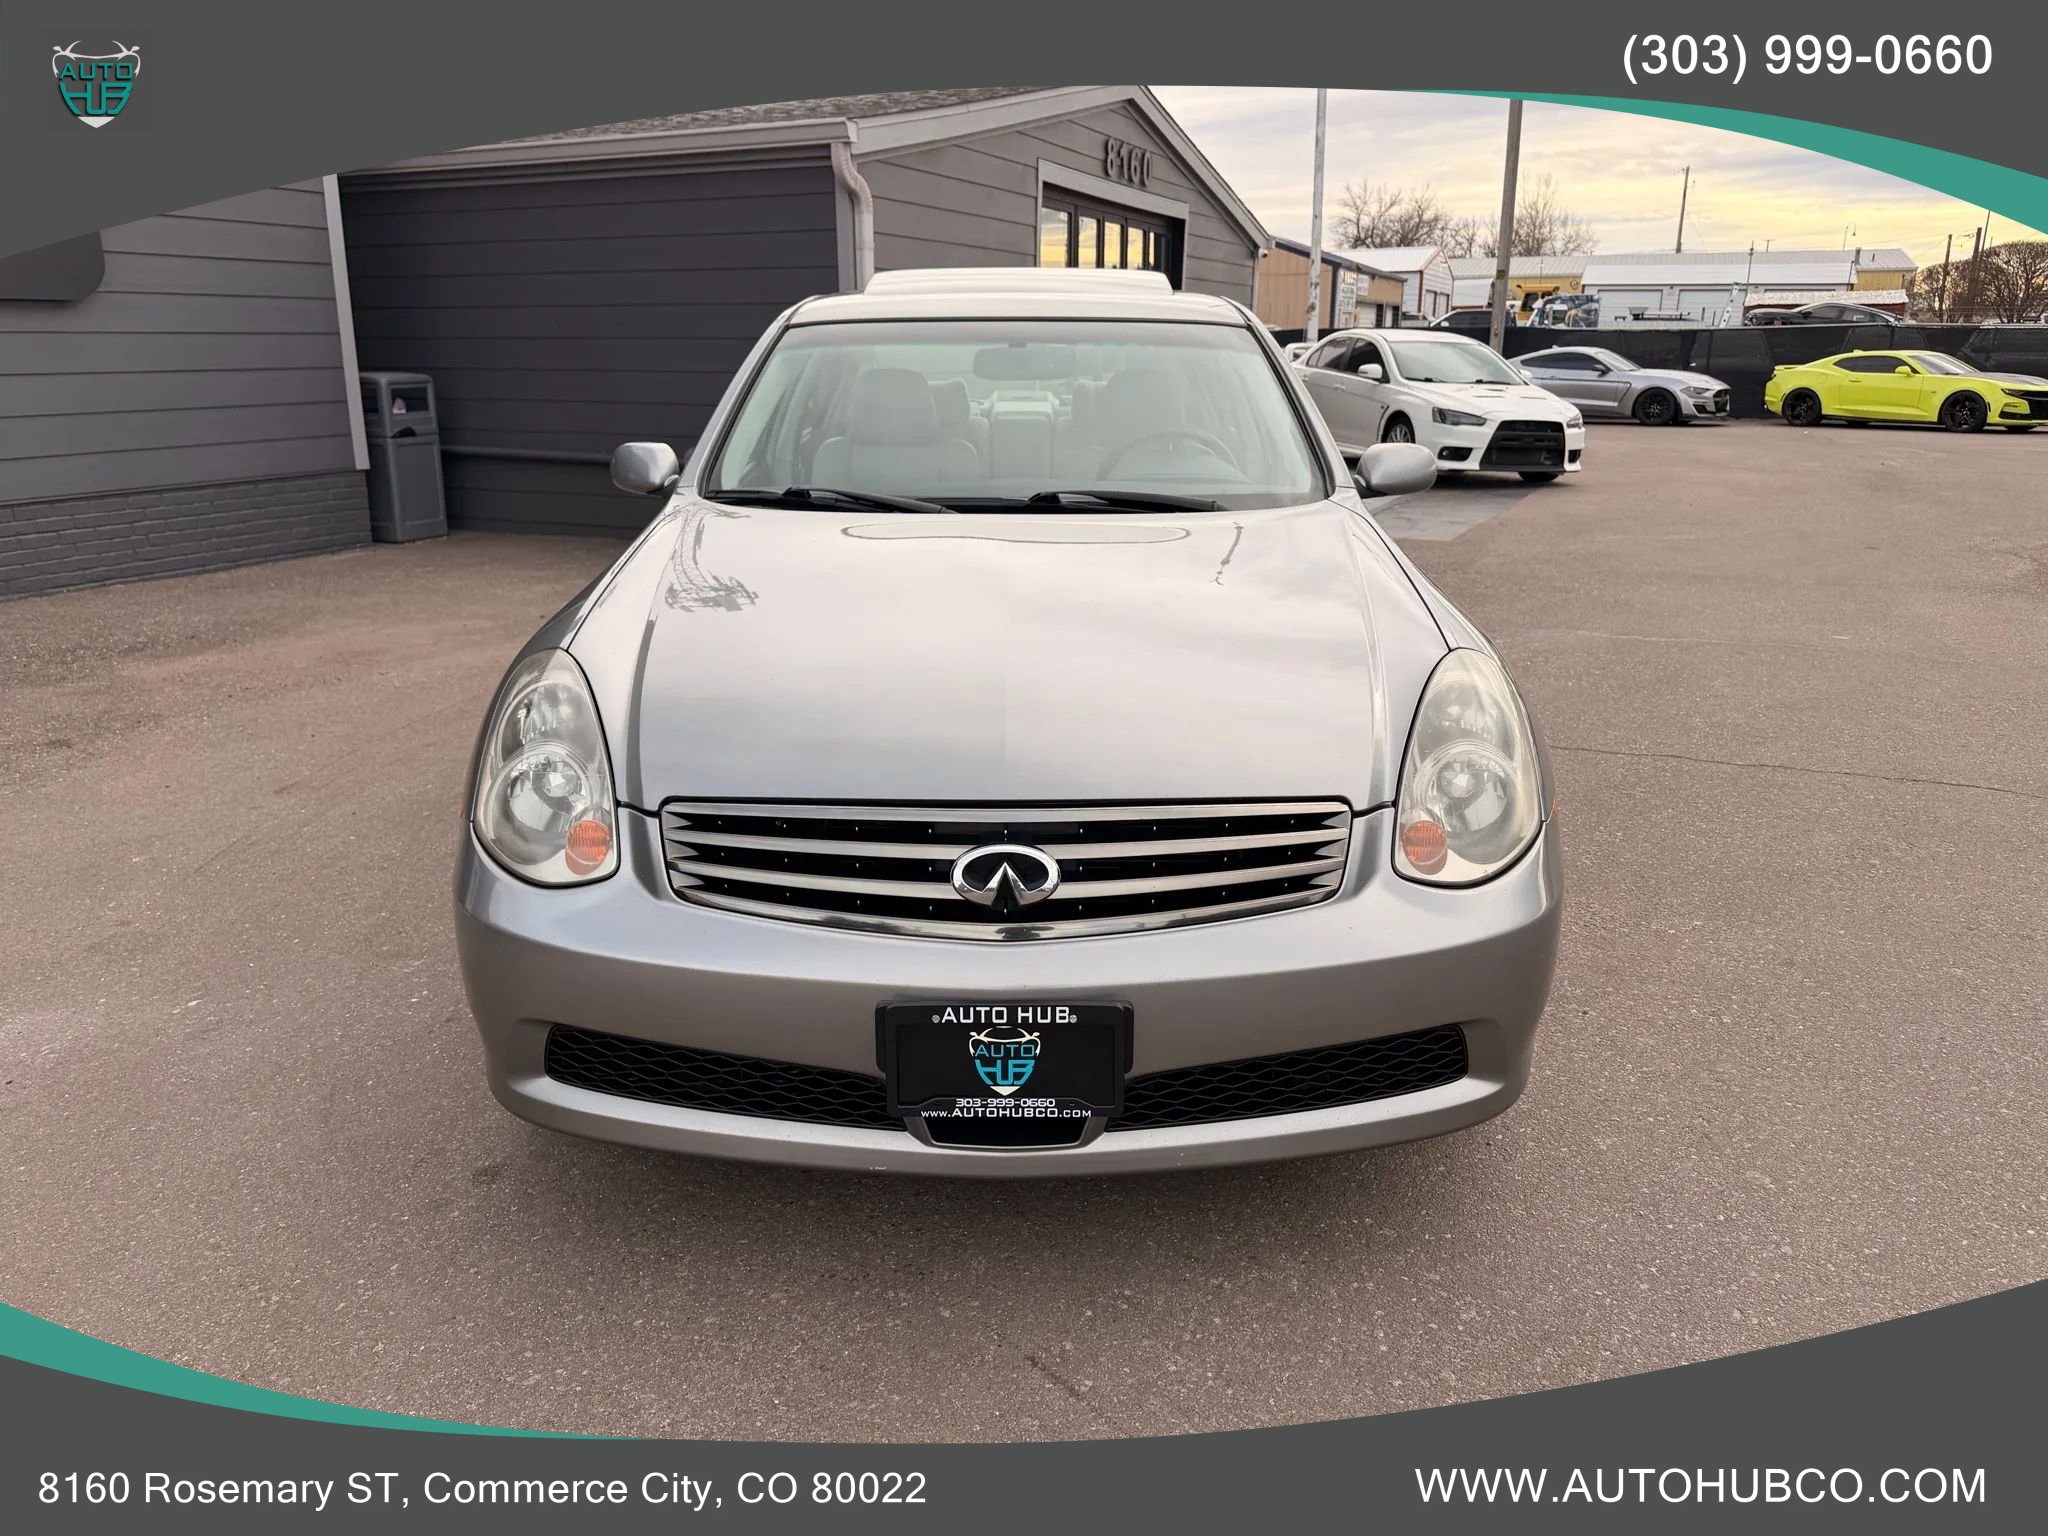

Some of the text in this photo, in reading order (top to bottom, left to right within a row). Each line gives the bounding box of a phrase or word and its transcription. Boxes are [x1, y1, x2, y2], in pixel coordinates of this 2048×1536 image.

[1105, 137, 1153, 187] 8160
[941, 1006, 1070, 1024] AUTO HUB
[975, 1044, 1035, 1057] AUTO
[974, 1059, 1035, 1085] HUB
[955, 1098, 1056, 1108] 303-999-0660
